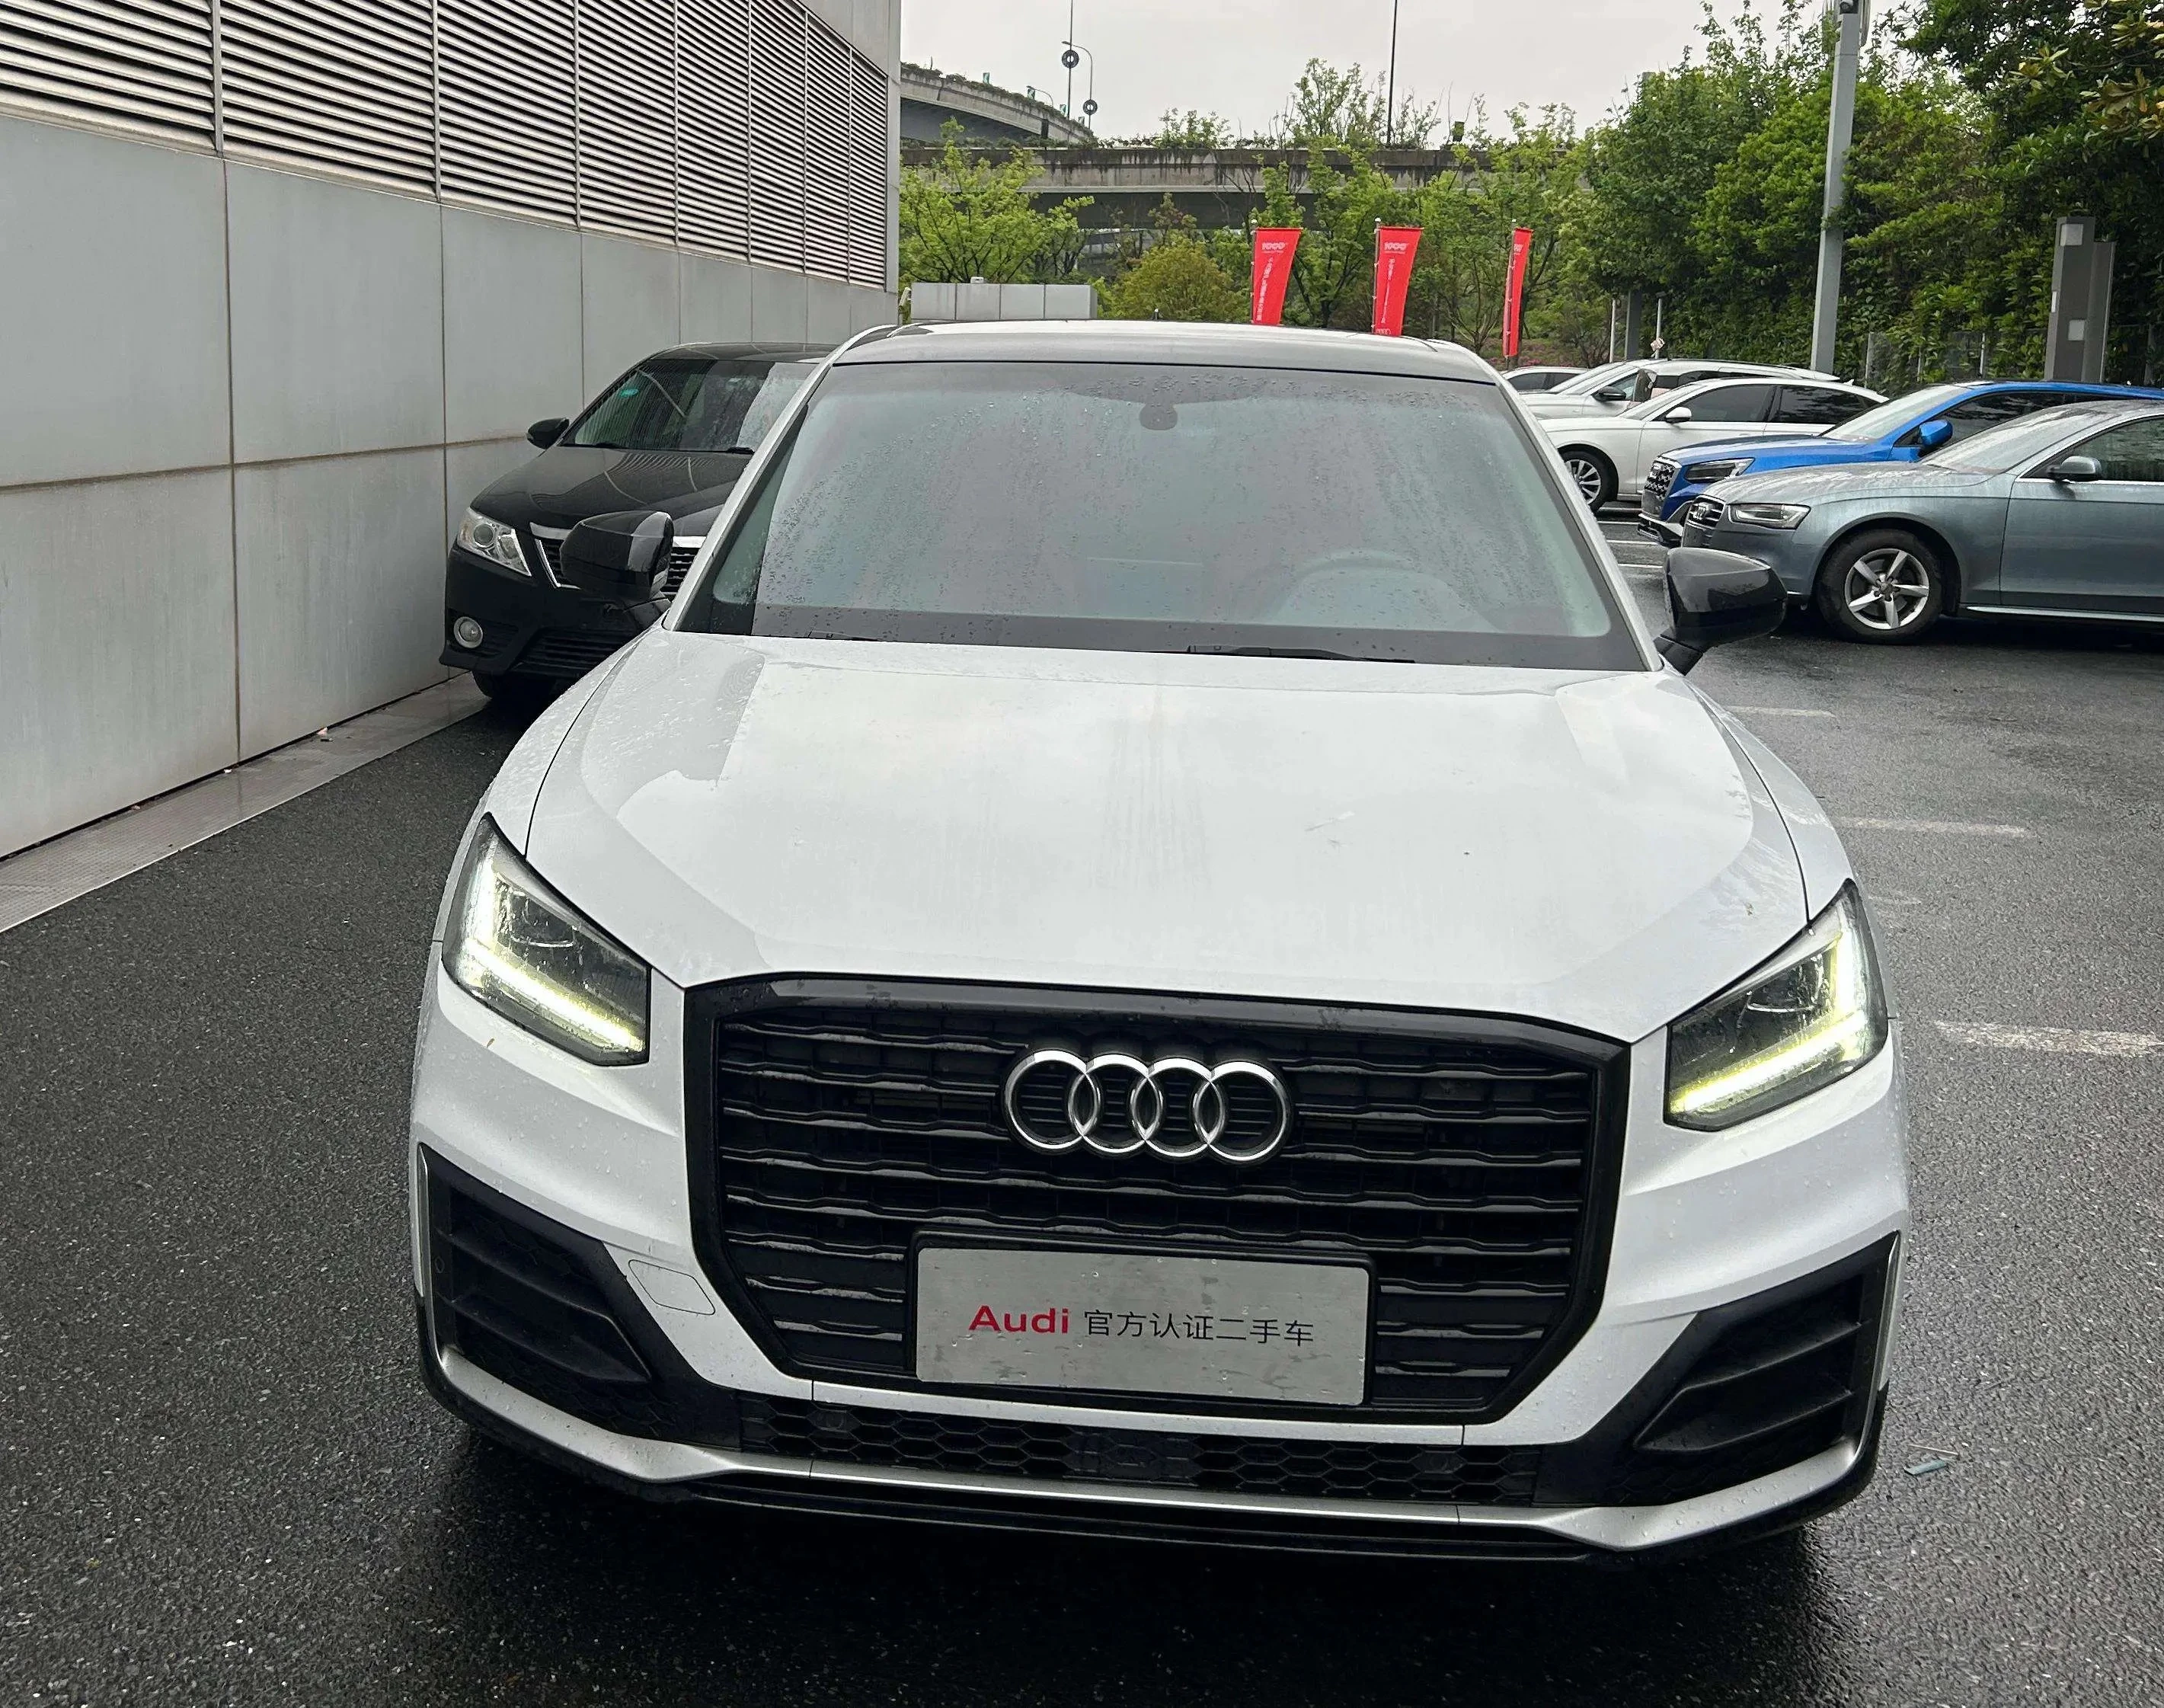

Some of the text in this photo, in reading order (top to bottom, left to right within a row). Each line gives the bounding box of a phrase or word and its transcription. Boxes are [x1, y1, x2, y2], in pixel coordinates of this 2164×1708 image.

[969, 1305, 1313, 1346] Audi 官方认证二手车
